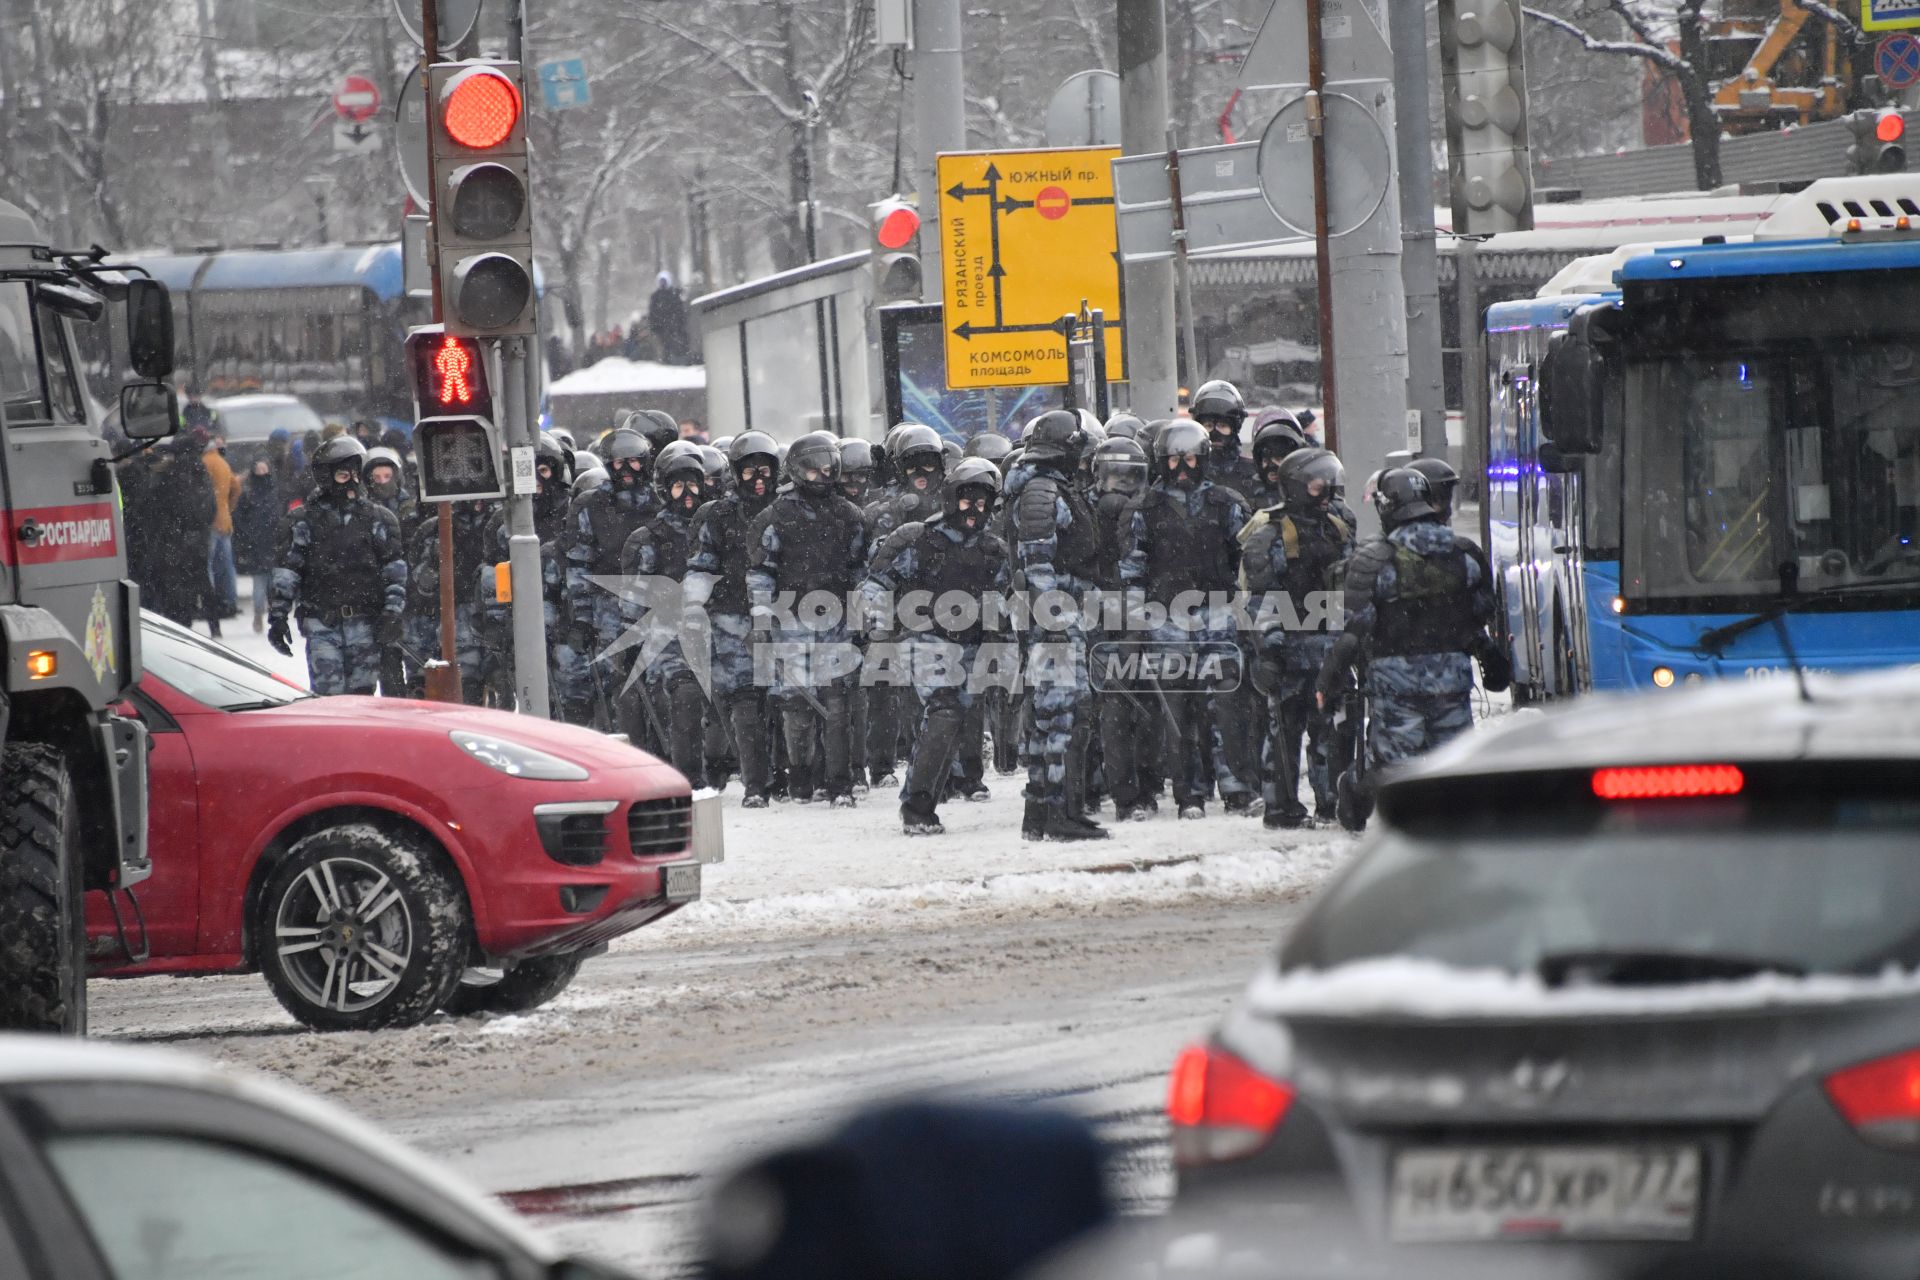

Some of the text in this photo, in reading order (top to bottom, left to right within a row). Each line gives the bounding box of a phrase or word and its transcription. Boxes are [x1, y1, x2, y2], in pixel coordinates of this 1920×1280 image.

[1009, 167, 1099, 183] ЮЖНЫЙ пр.
[951, 217, 968, 308] РЯЗАНСКИЙ
[973, 255, 987, 307] проезд
[970, 366, 1031, 377] площадь
[38, 518, 111, 547] РОСГВАРДИЯ
